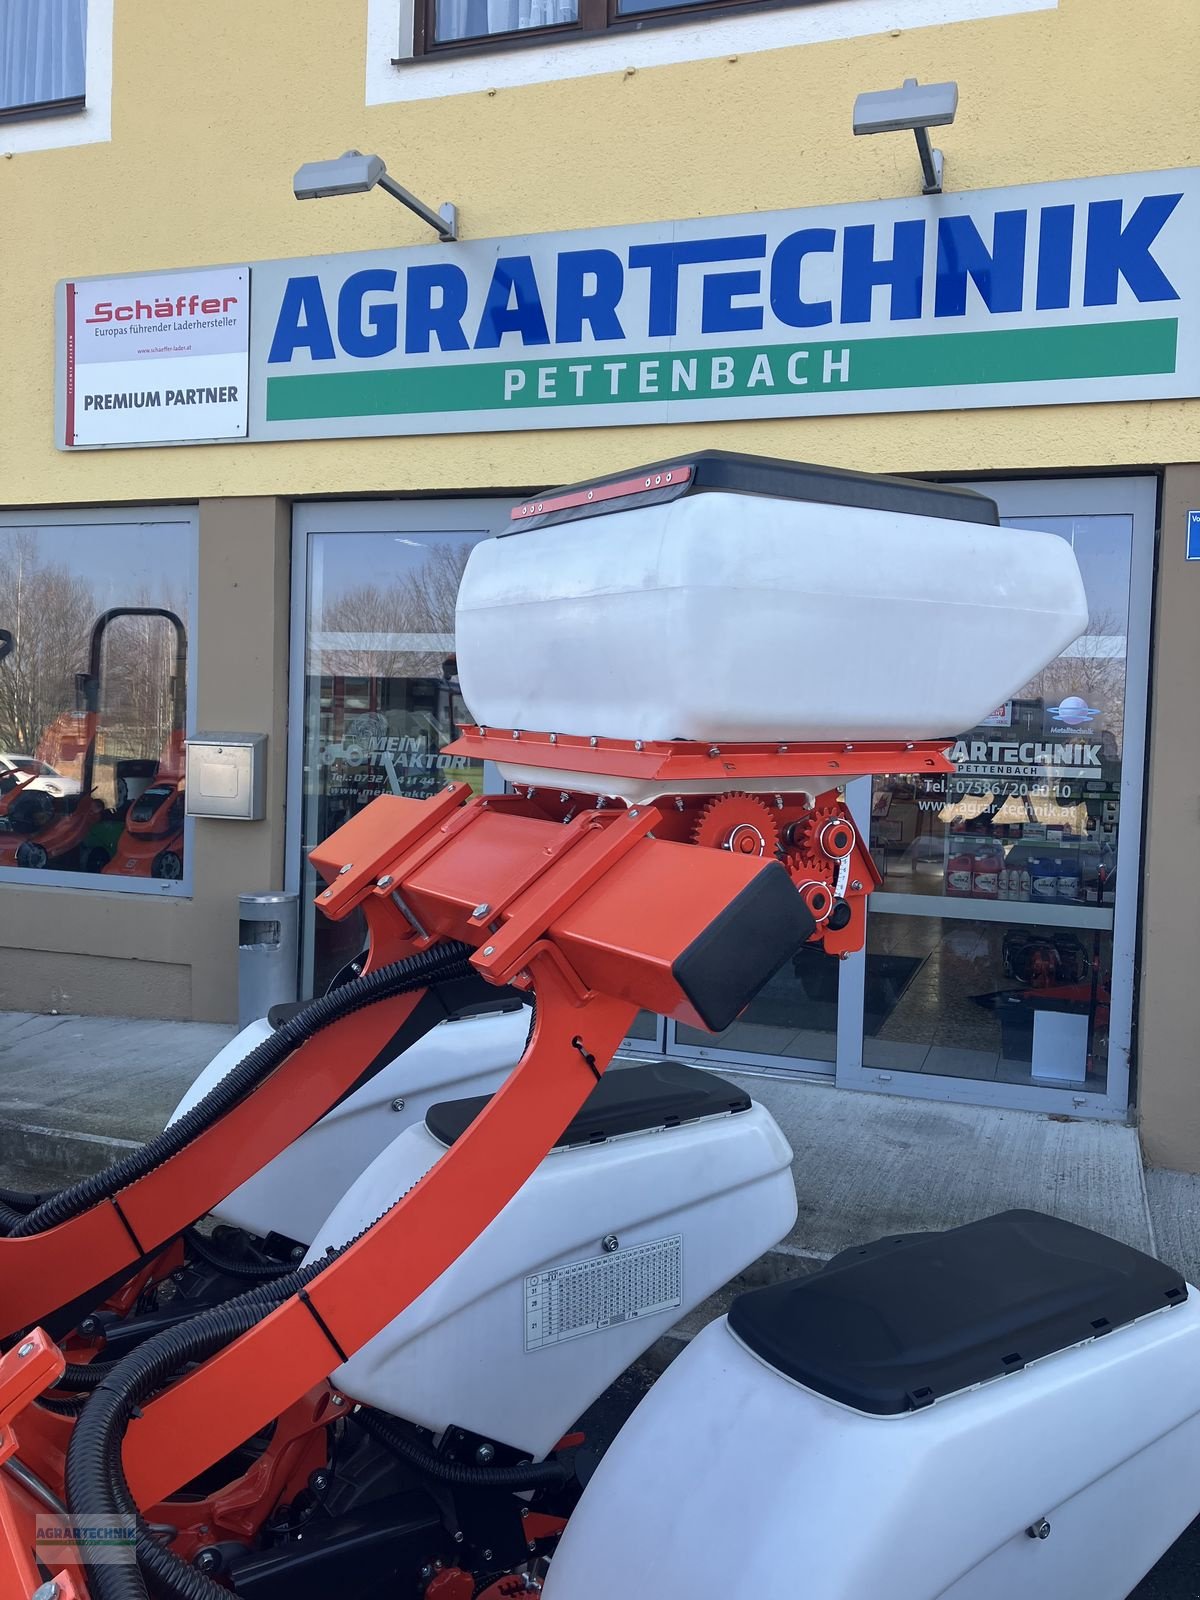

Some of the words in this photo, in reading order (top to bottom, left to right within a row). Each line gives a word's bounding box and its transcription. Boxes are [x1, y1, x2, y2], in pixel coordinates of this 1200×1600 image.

[268, 192, 1184, 363] AGRARTECHNIK
[86, 295, 238, 323] Schäffer
[94, 326, 128, 338] Europas
[130, 322, 172, 334] führender
[173, 317, 237, 330] Laderhersteller
[504, 348, 850, 400] PETTENBACH
[84, 391, 161, 410] PREMIUM
[165, 386, 238, 406] PARTNER
[368, 736, 421, 752] MEIN
[958, 765, 1038, 775] PETTENBACH
[924, 779, 952, 792] Tel.:
[1055, 785, 1072, 798] 10
[918, 800, 1076, 817] www.agrar-technik.at
